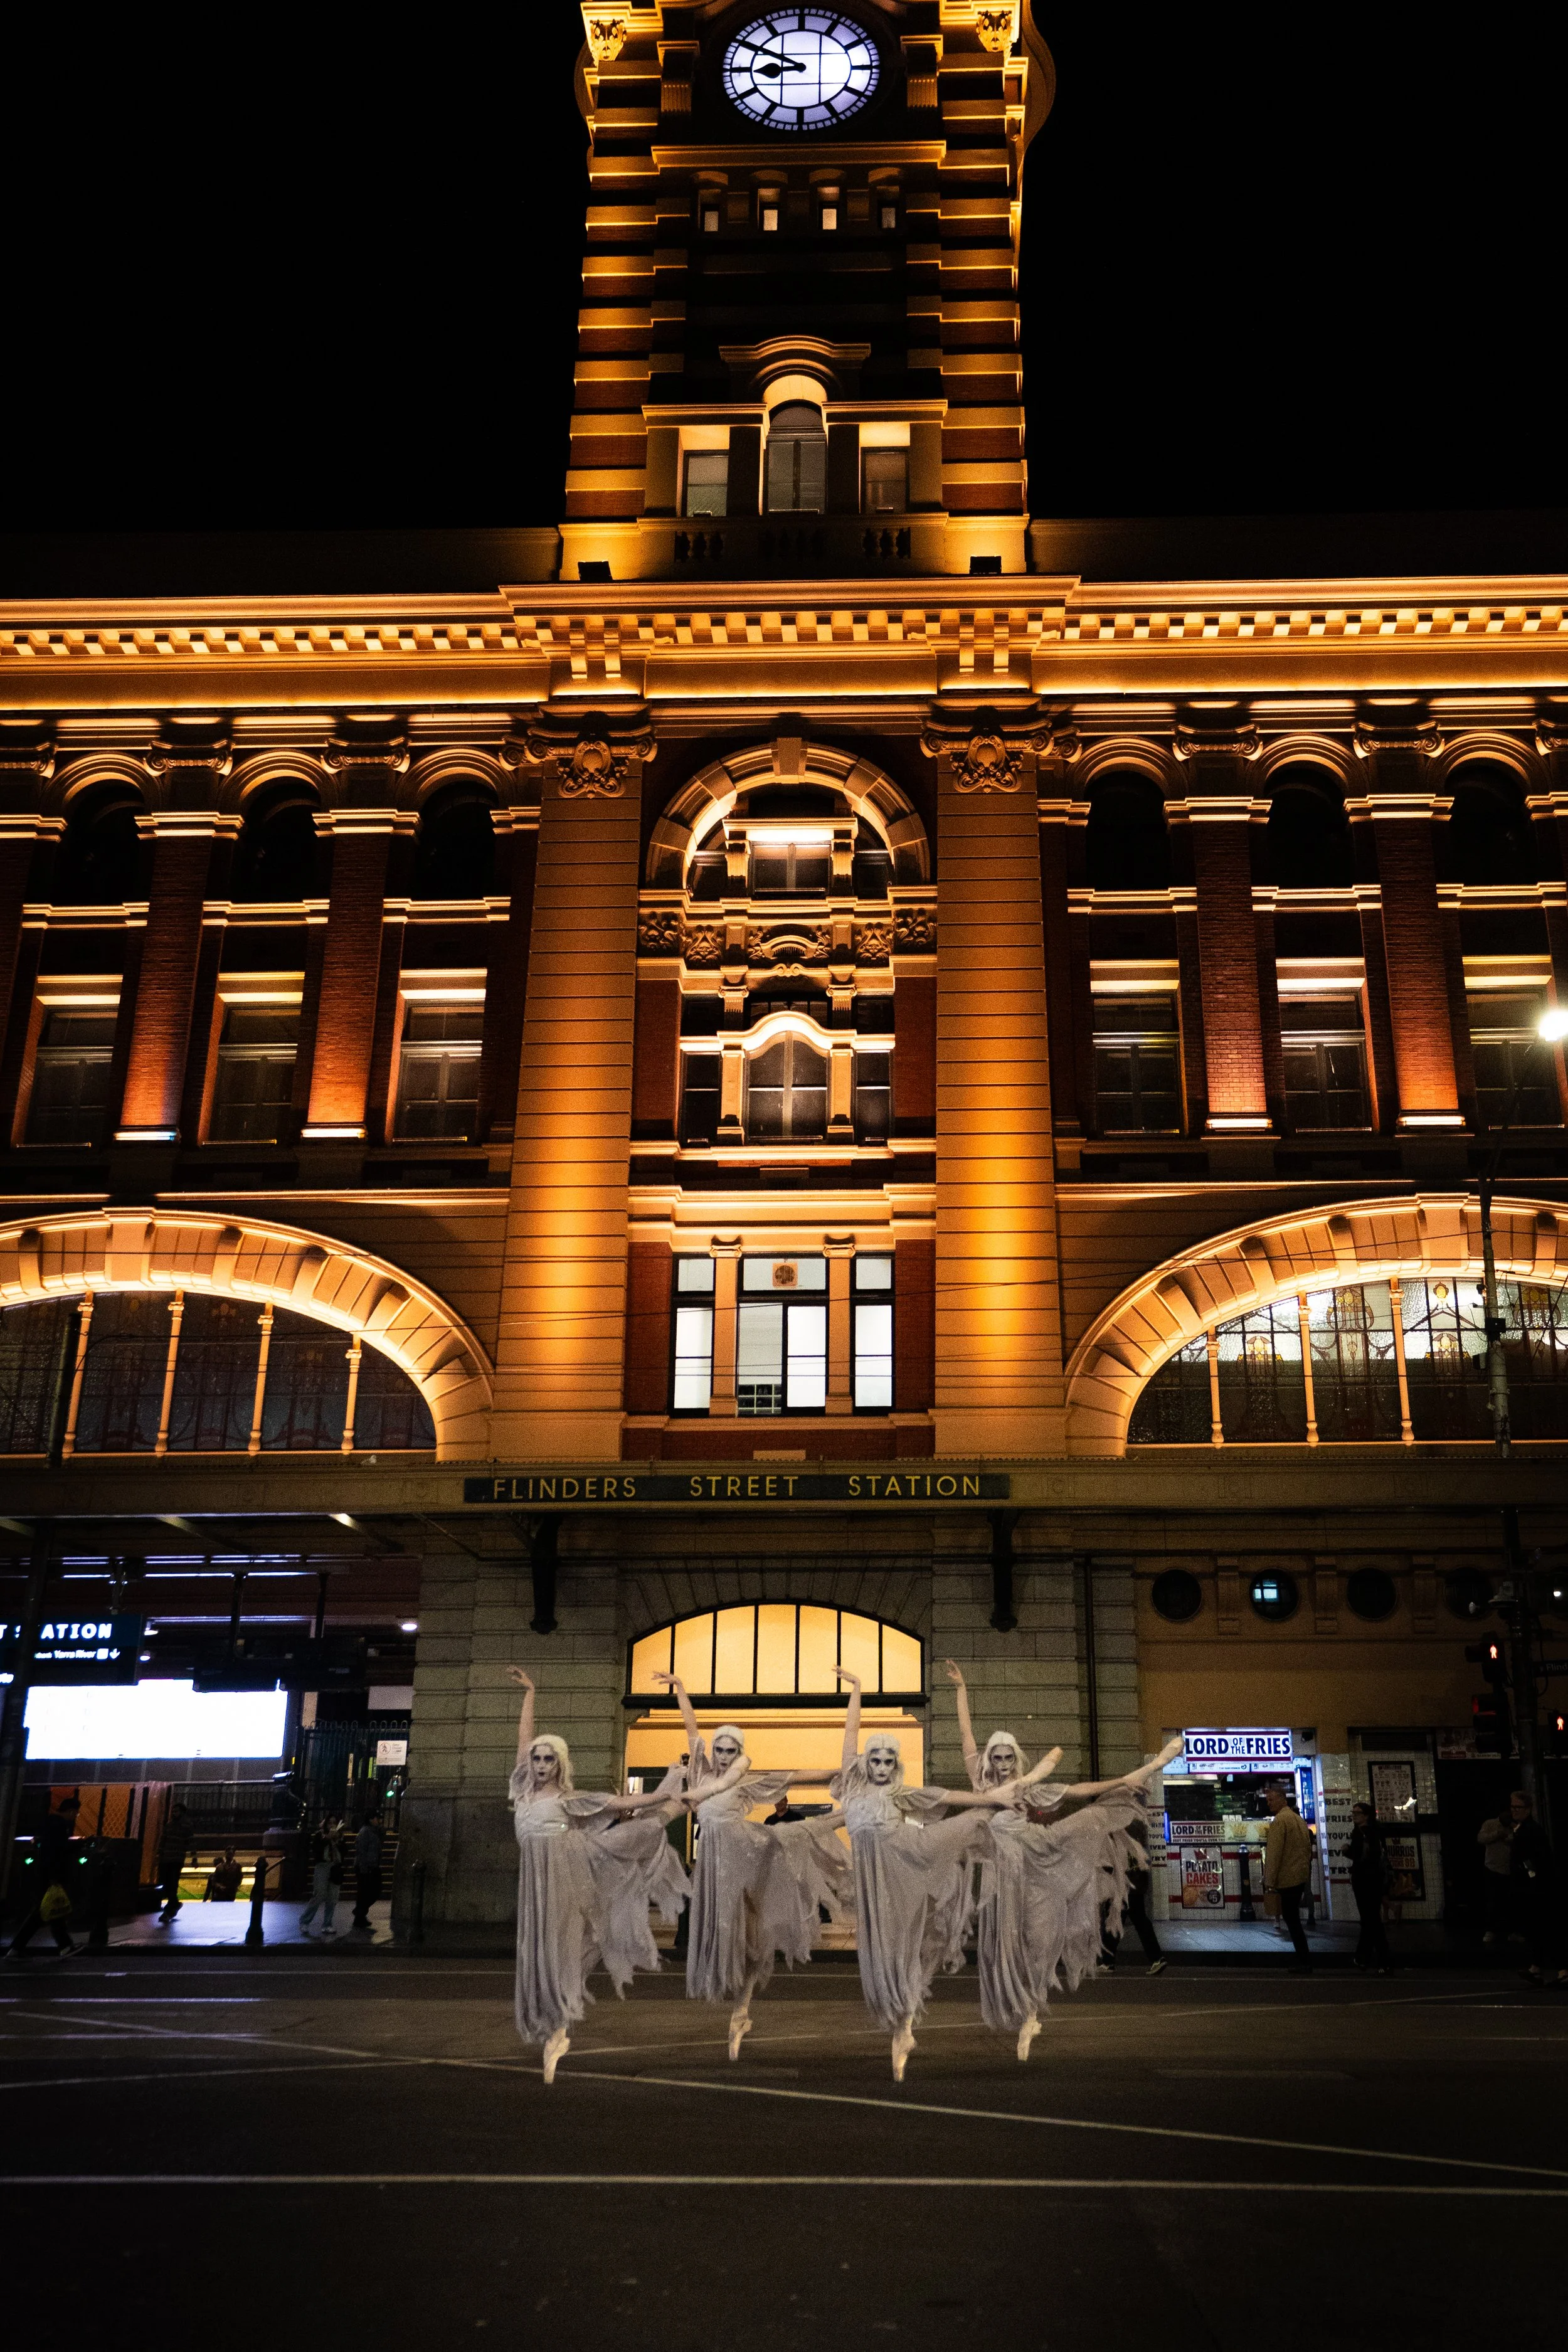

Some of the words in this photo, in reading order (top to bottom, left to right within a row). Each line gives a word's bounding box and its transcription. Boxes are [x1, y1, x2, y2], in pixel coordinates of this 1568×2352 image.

[493, 1477, 636, 1500] FLINDERS
[689, 1476, 798, 1497] STREET
[848, 1474, 980, 1496] STATION
[15, 1623, 112, 1639] ATION
[1185, 1738, 1229, 1755] LORD
[1232, 1737, 1243, 1745] OF
[1246, 1737, 1291, 1755] FRIES
[1231, 1745, 1246, 1754] THE
[1172, 1826, 1194, 1835] LORD
[1202, 1825, 1225, 1835] FRIES
[1387, 1845, 1415, 1857] HURROS
[1186, 1873, 1219, 1885] CAKES
